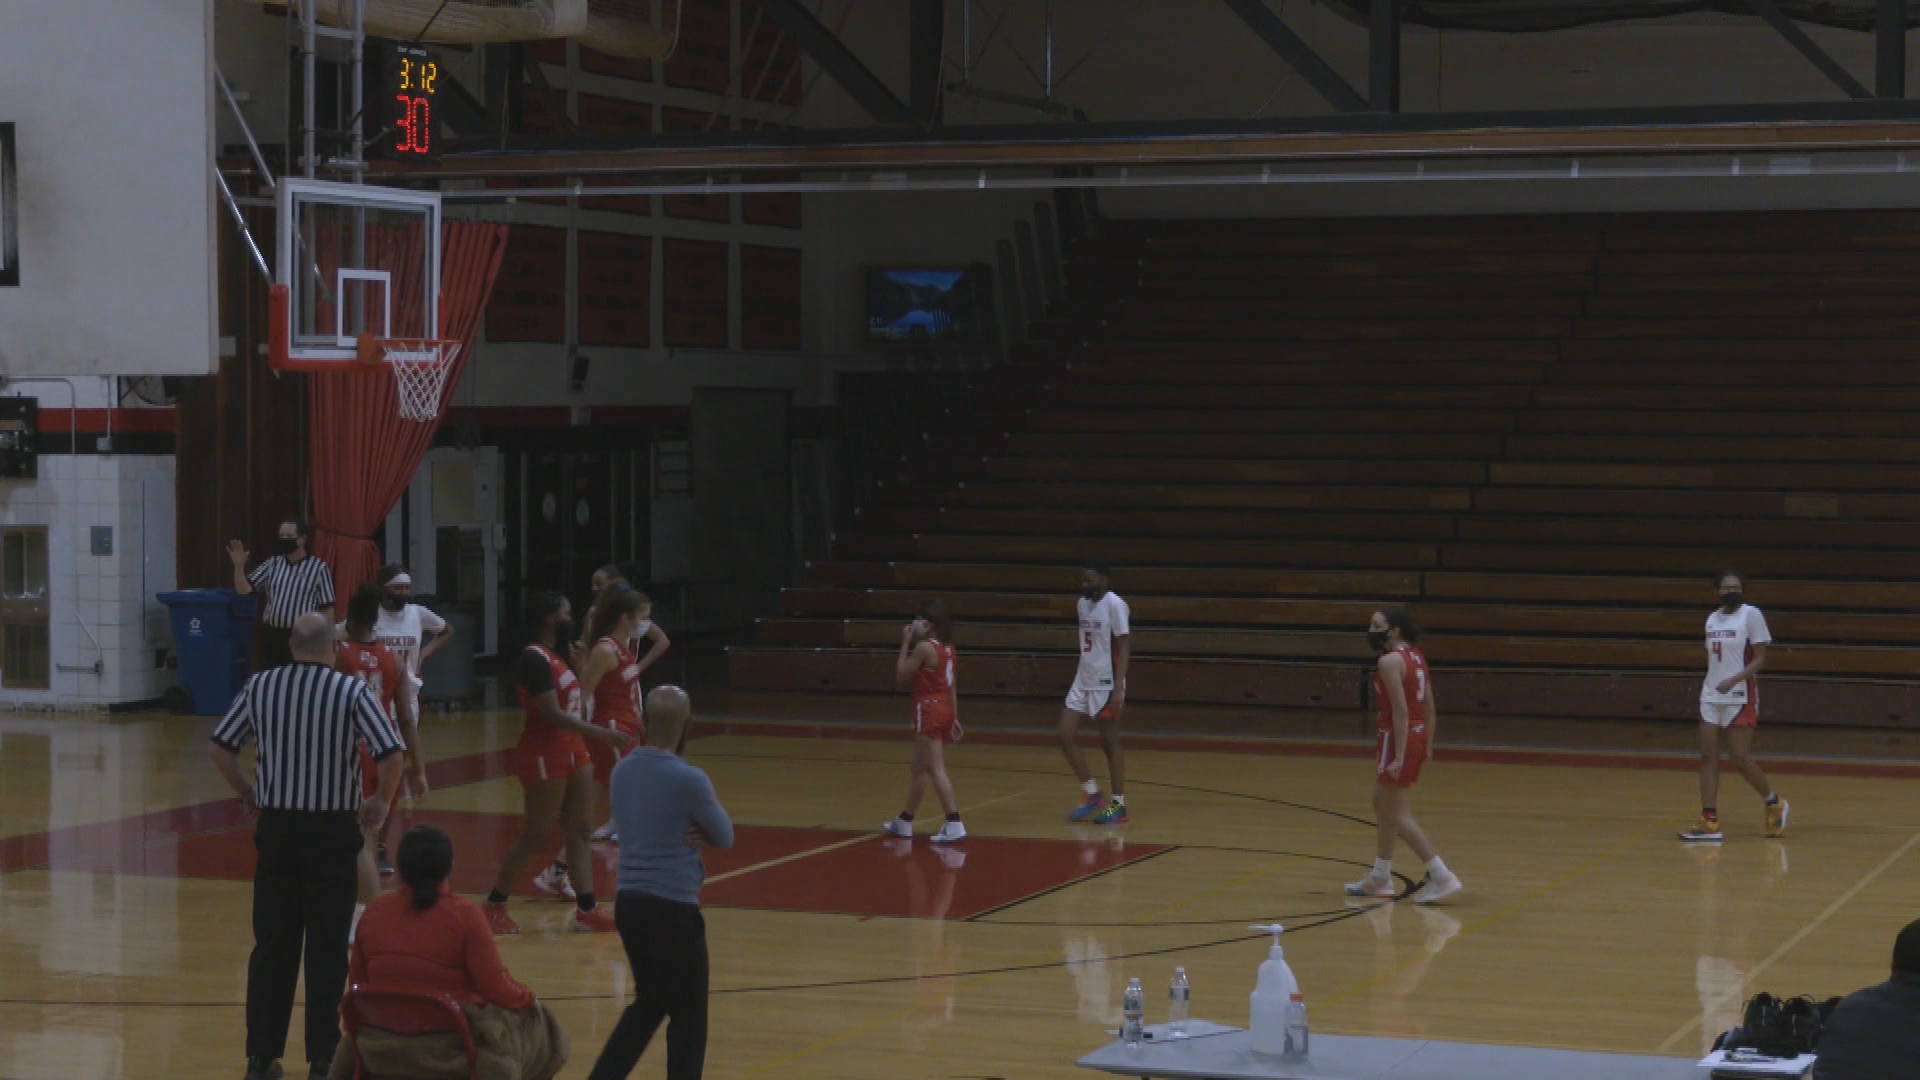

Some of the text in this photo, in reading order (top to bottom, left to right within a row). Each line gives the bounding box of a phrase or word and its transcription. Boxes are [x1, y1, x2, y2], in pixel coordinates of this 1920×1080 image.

[400, 58, 438, 93] 3:12
[396, 95, 430, 153] 30
[1083, 631, 1092, 653] 5
[1712, 641, 1722, 663] 4
